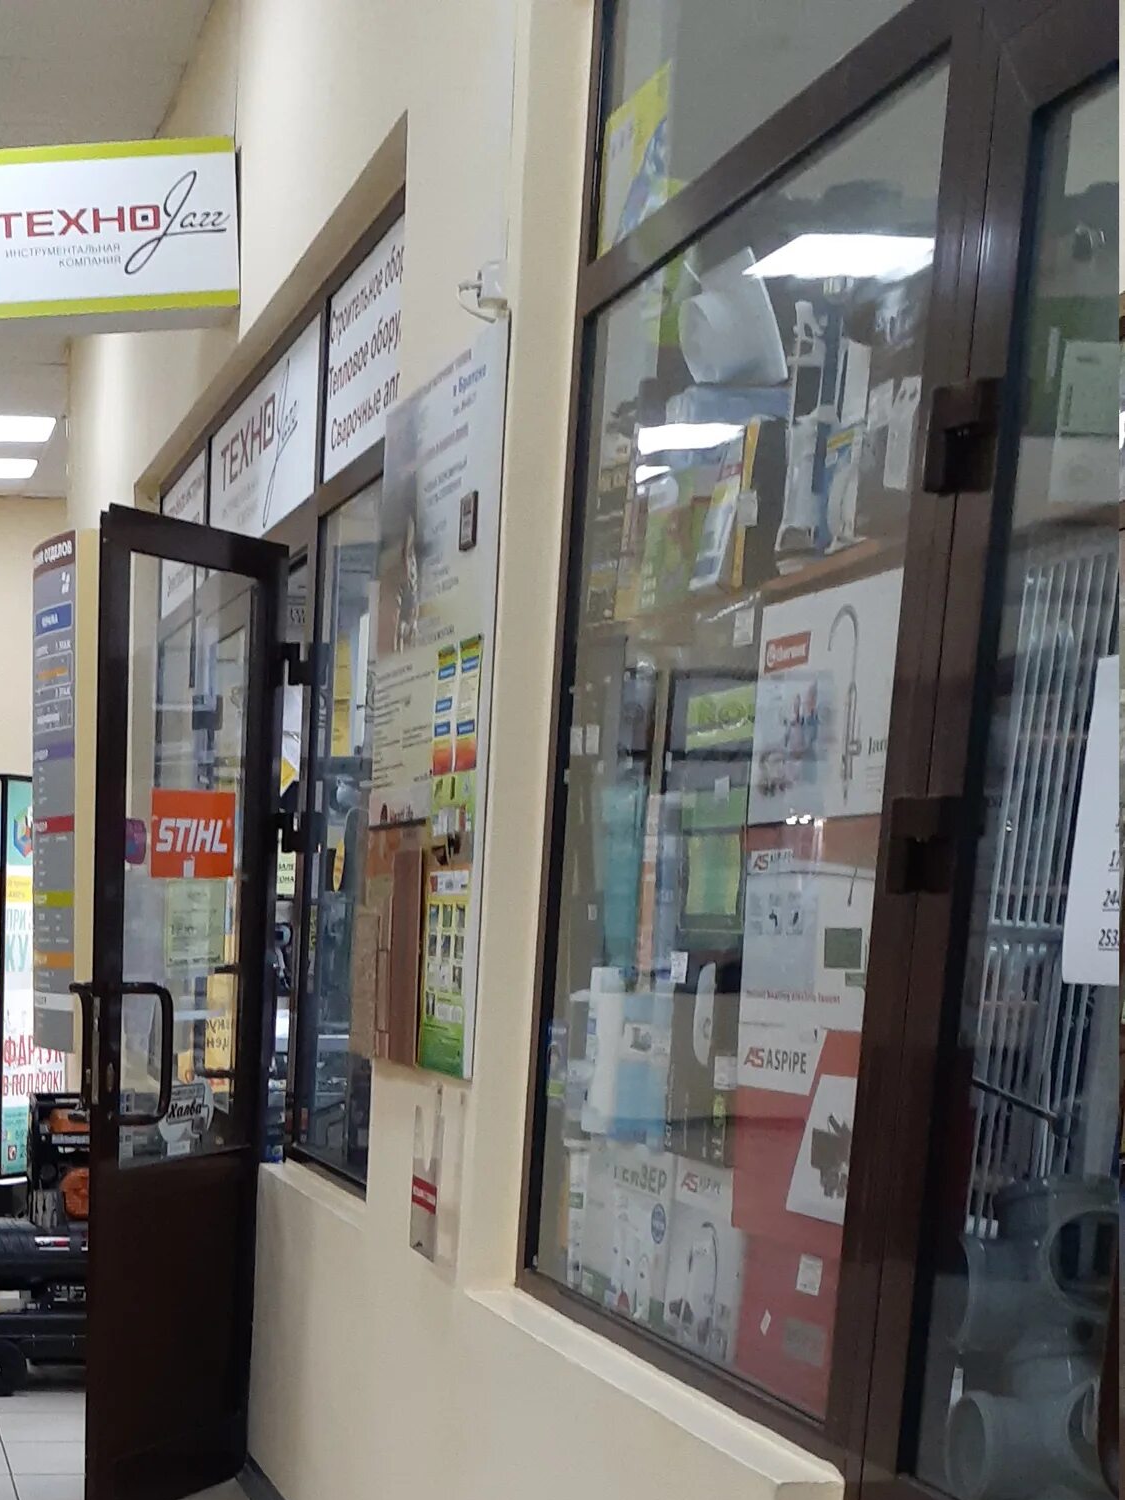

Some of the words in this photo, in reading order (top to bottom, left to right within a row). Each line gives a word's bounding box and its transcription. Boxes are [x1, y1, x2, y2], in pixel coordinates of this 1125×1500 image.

[5, 243, 122, 259] ИНСТРУМЕНТАЛЬНАЯ
[58, 255, 123, 268] КОМПАНИЯ
[329, 340, 369, 399] Тепловое
[330, 391, 381, 451] Сварочные
[156, 817, 228, 854] STIHL
